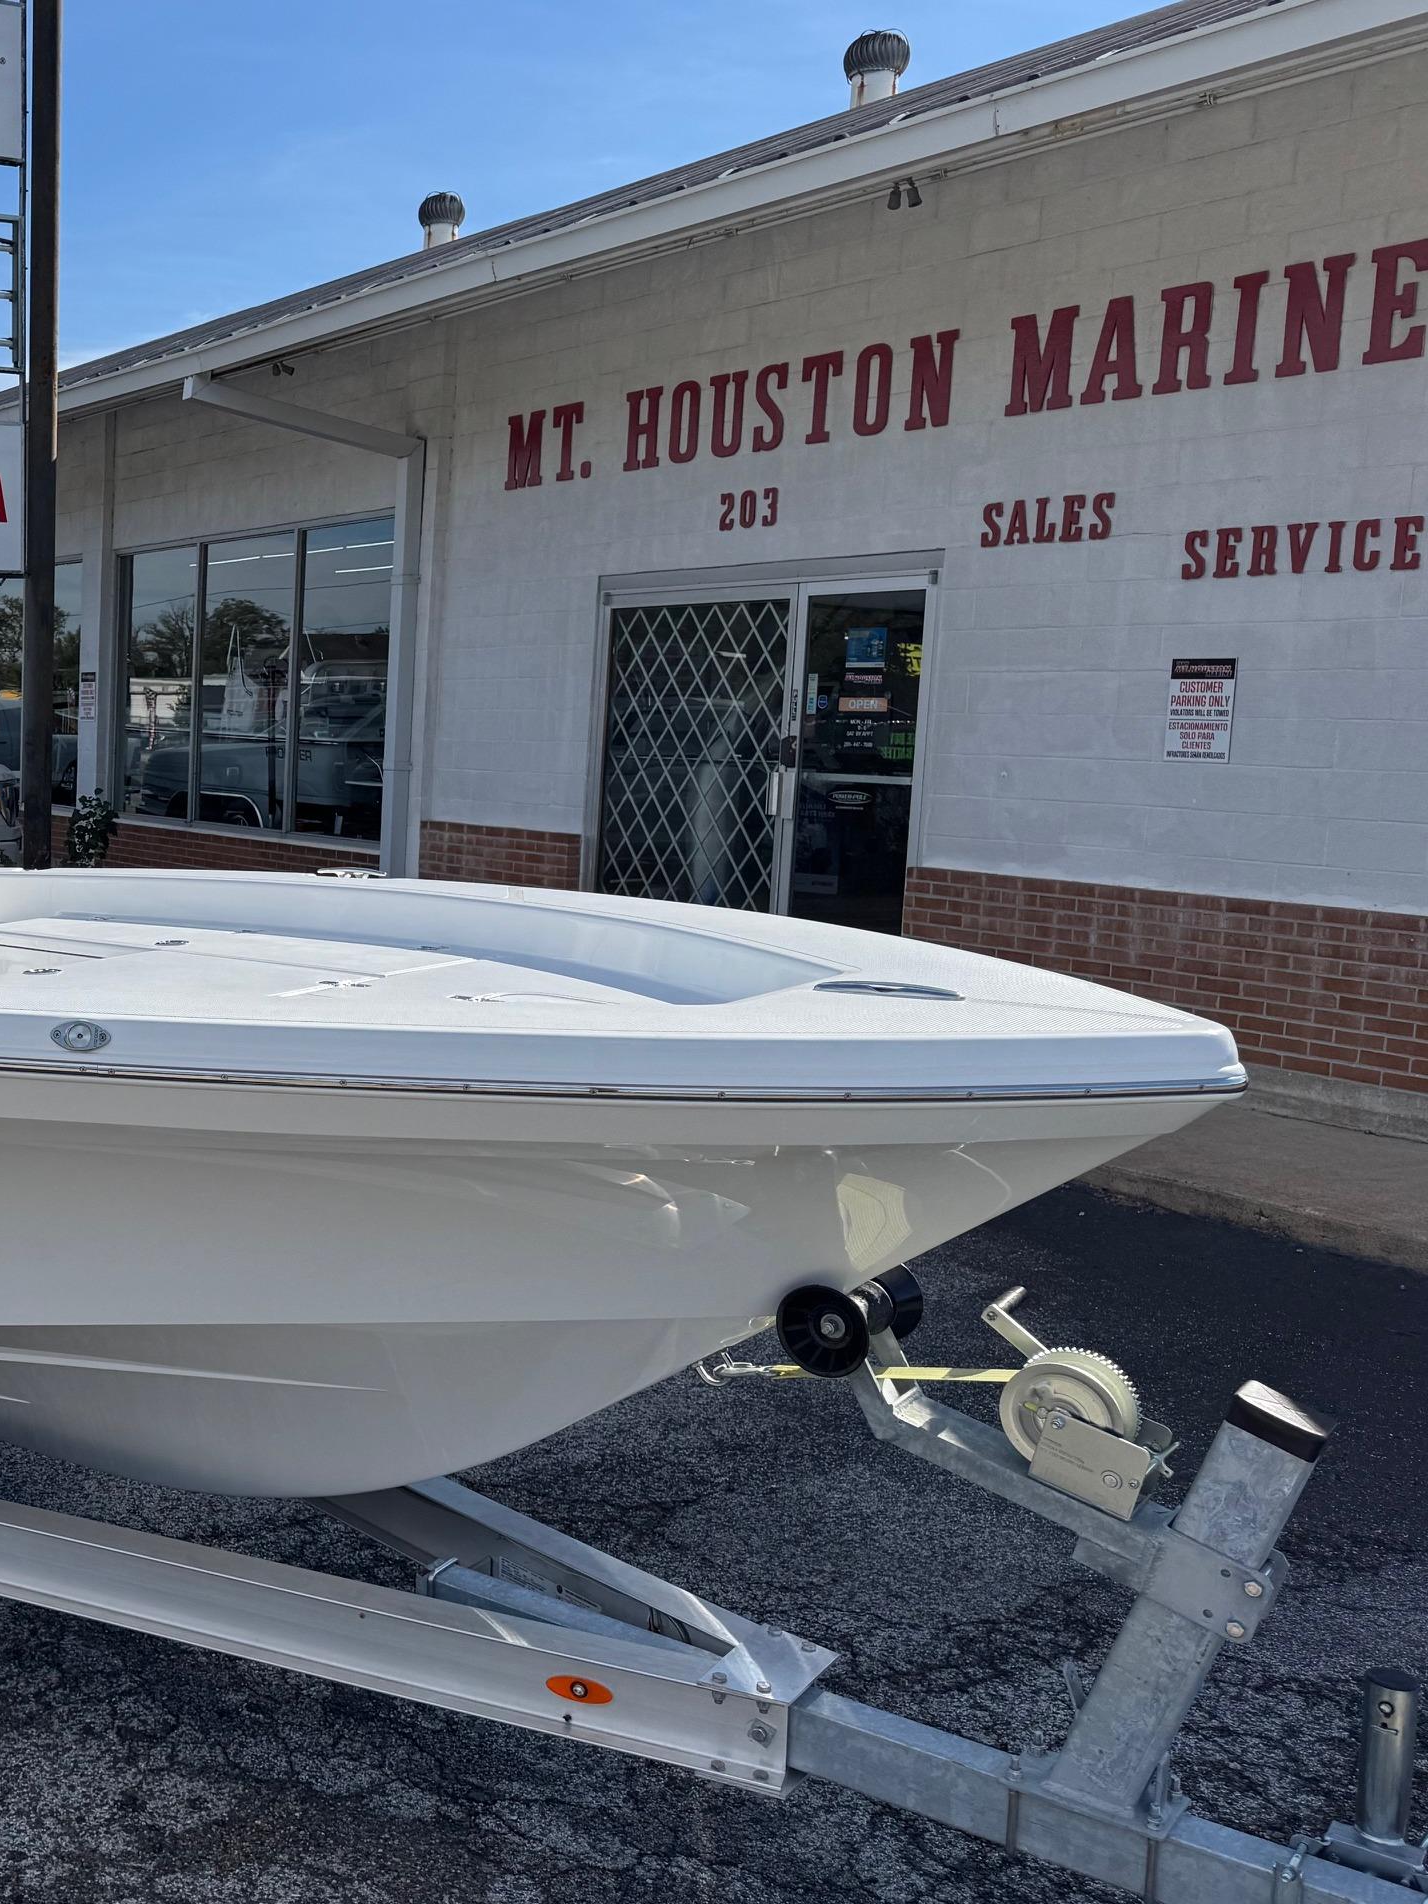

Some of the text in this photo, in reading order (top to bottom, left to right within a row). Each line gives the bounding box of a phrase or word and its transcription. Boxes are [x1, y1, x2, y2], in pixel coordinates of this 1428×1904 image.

[504, 238, 1428, 491] MT. HOUSTON MARINE
[719, 487, 779, 531] 203
[980, 491, 1116, 549] SALES
[1181, 515, 1424, 580] SERVICE
[1179, 681, 1224, 693] CUSTOMER
[848, 699, 878, 709] OPEN
[1170, 695, 1230, 708] PARKING ONLY
[1170, 708, 1229, 717] VIOLATORS WILL BE TOWED
[1168, 722, 1228, 731] ESTACIONAMIENTO
[1179, 731, 1215, 740] SOLO PARA
[1181, 741, 1211, 750] CLIENTES
